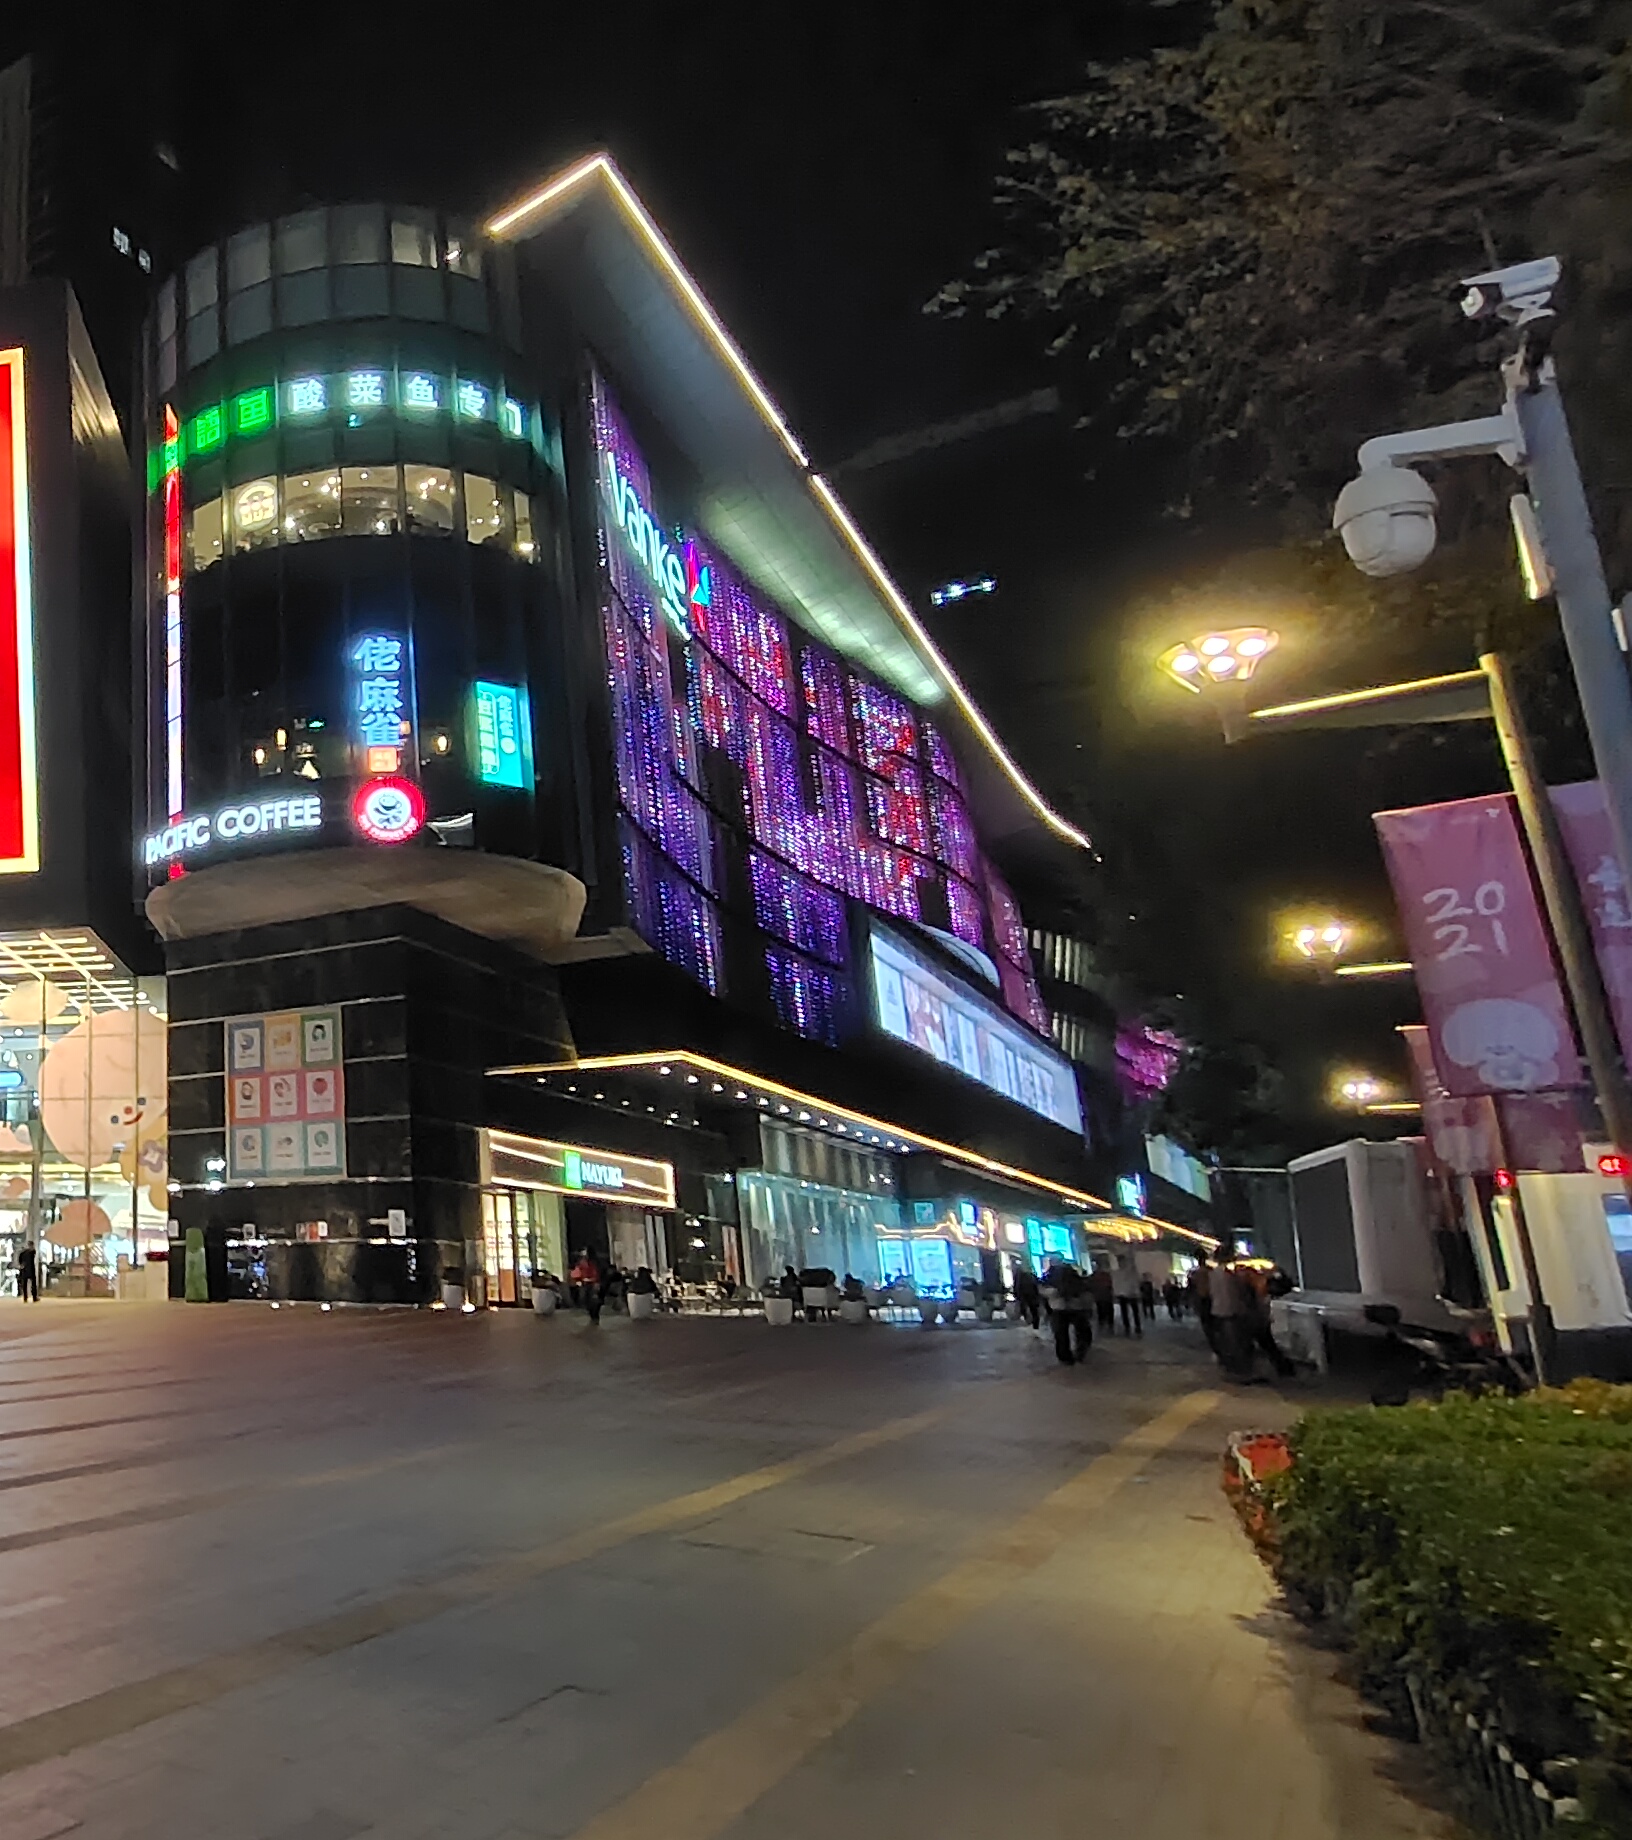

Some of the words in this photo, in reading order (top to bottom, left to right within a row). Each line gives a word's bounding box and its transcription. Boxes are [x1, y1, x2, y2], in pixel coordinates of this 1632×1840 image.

[607, 451, 688, 617] vanke
[354, 636, 403, 746] 佬麻雀
[217, 794, 321, 838] COFFEE
[1423, 881, 1505, 923] 20
[1434, 919, 1510, 962] 21
